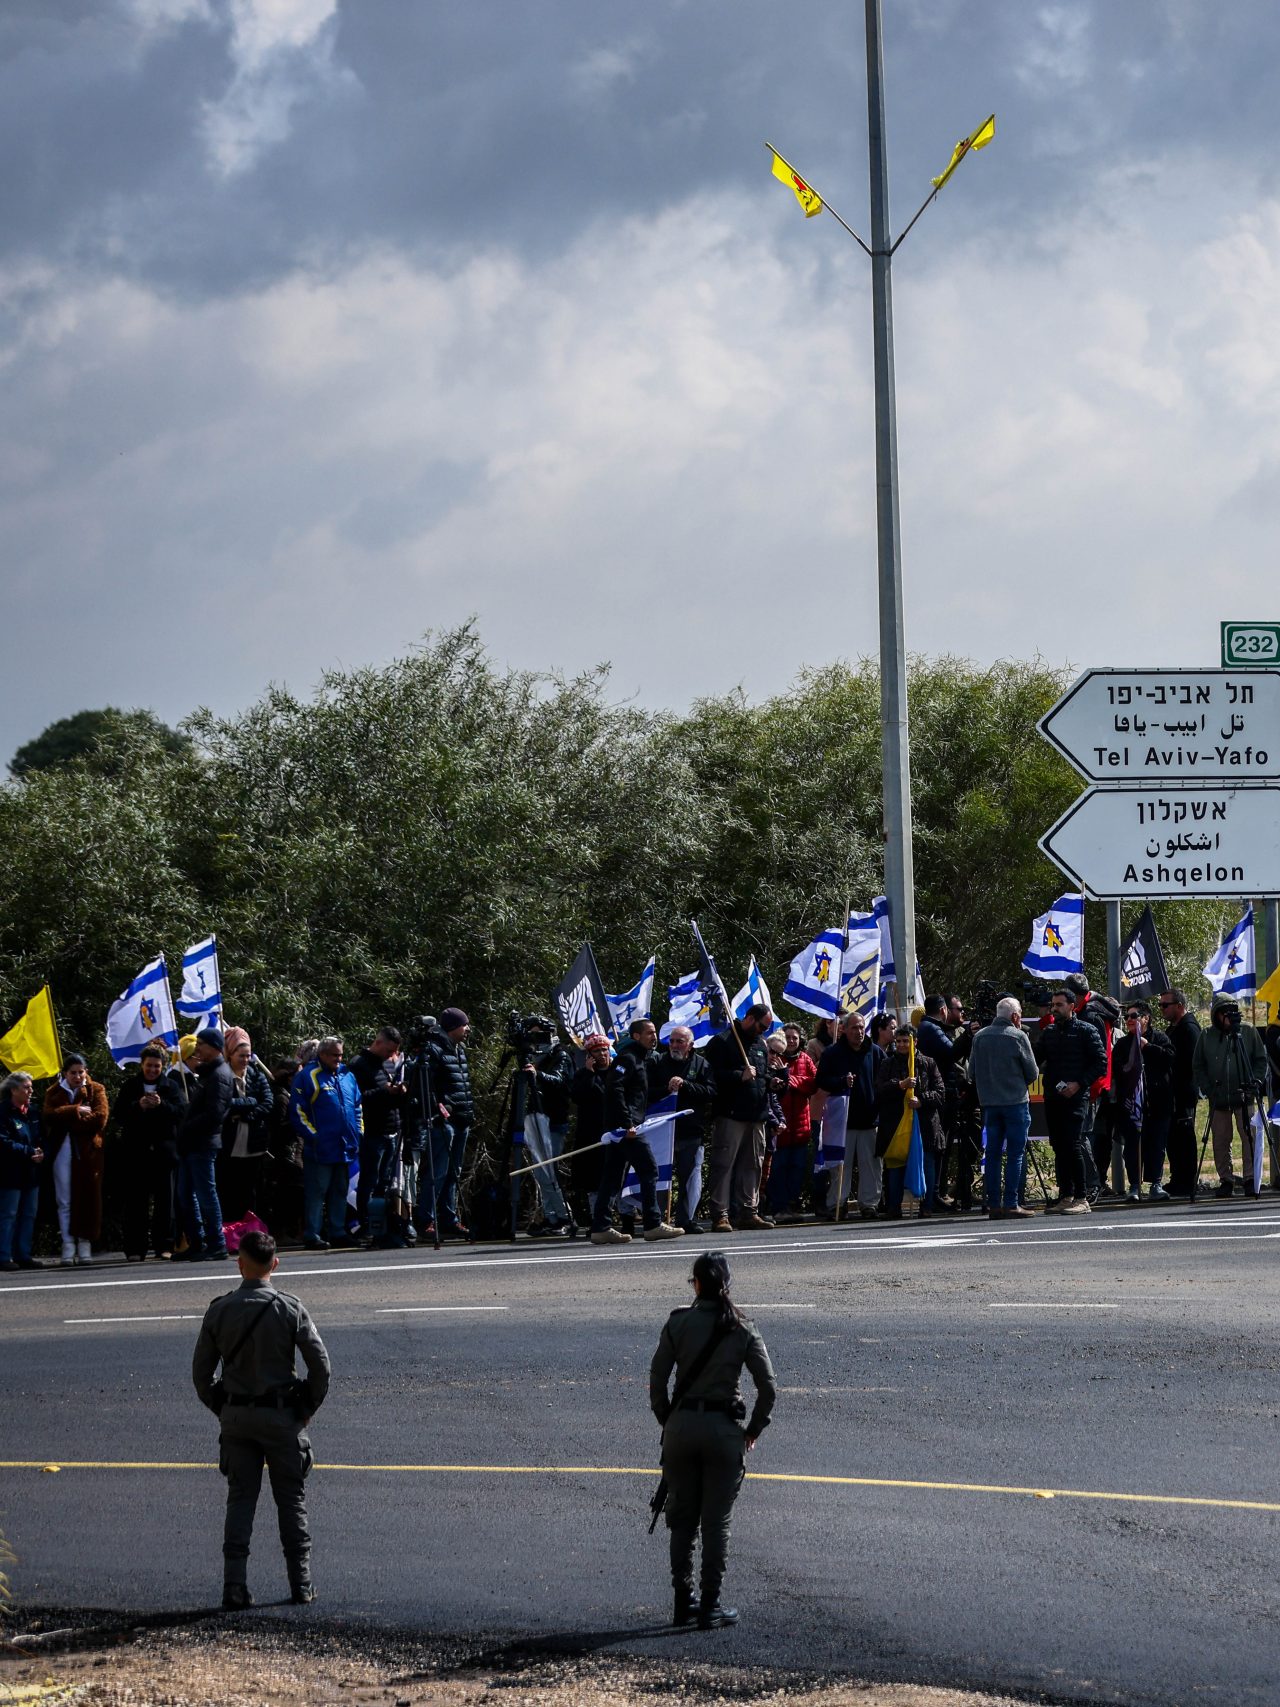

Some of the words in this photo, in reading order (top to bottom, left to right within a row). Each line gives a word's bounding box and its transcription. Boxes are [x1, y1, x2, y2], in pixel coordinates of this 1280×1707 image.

[1234, 635, 1274, 653] 232
[1108, 685, 1211, 705] אביב-יפו
[1226, 681, 1254, 704] תל
[1220, 713, 1246, 740] تل
[1093, 747, 1129, 766] Tel
[1144, 746, 1269, 766] Aviv-Yafo
[1136, 798, 1227, 824] אשקלון
[1122, 863, 1244, 887] Ashqelon
